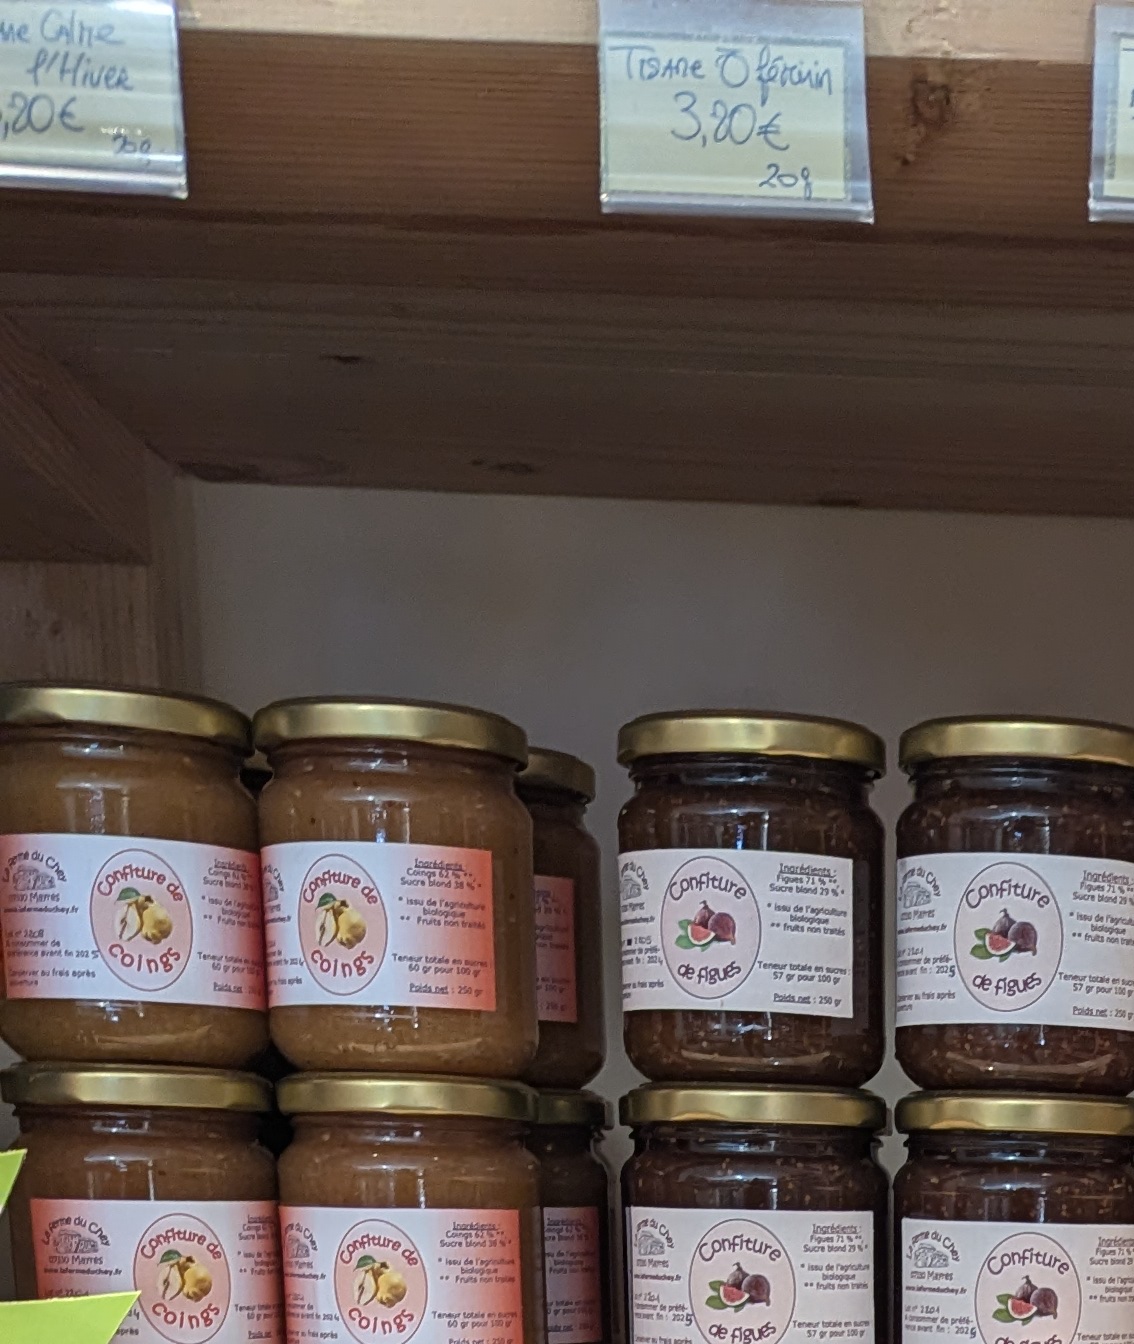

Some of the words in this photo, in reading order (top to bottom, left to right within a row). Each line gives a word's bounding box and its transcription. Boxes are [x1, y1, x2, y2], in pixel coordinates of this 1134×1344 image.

[303, 870, 361, 904] Confiture
[361, 885, 379, 906] de
[669, 872, 746, 900] Confiture
[311, 949, 375, 979] Coings
[677, 963, 695, 980] de
[697, 961, 741, 985] figues
[987, 1248, 1069, 1276] Confiture
